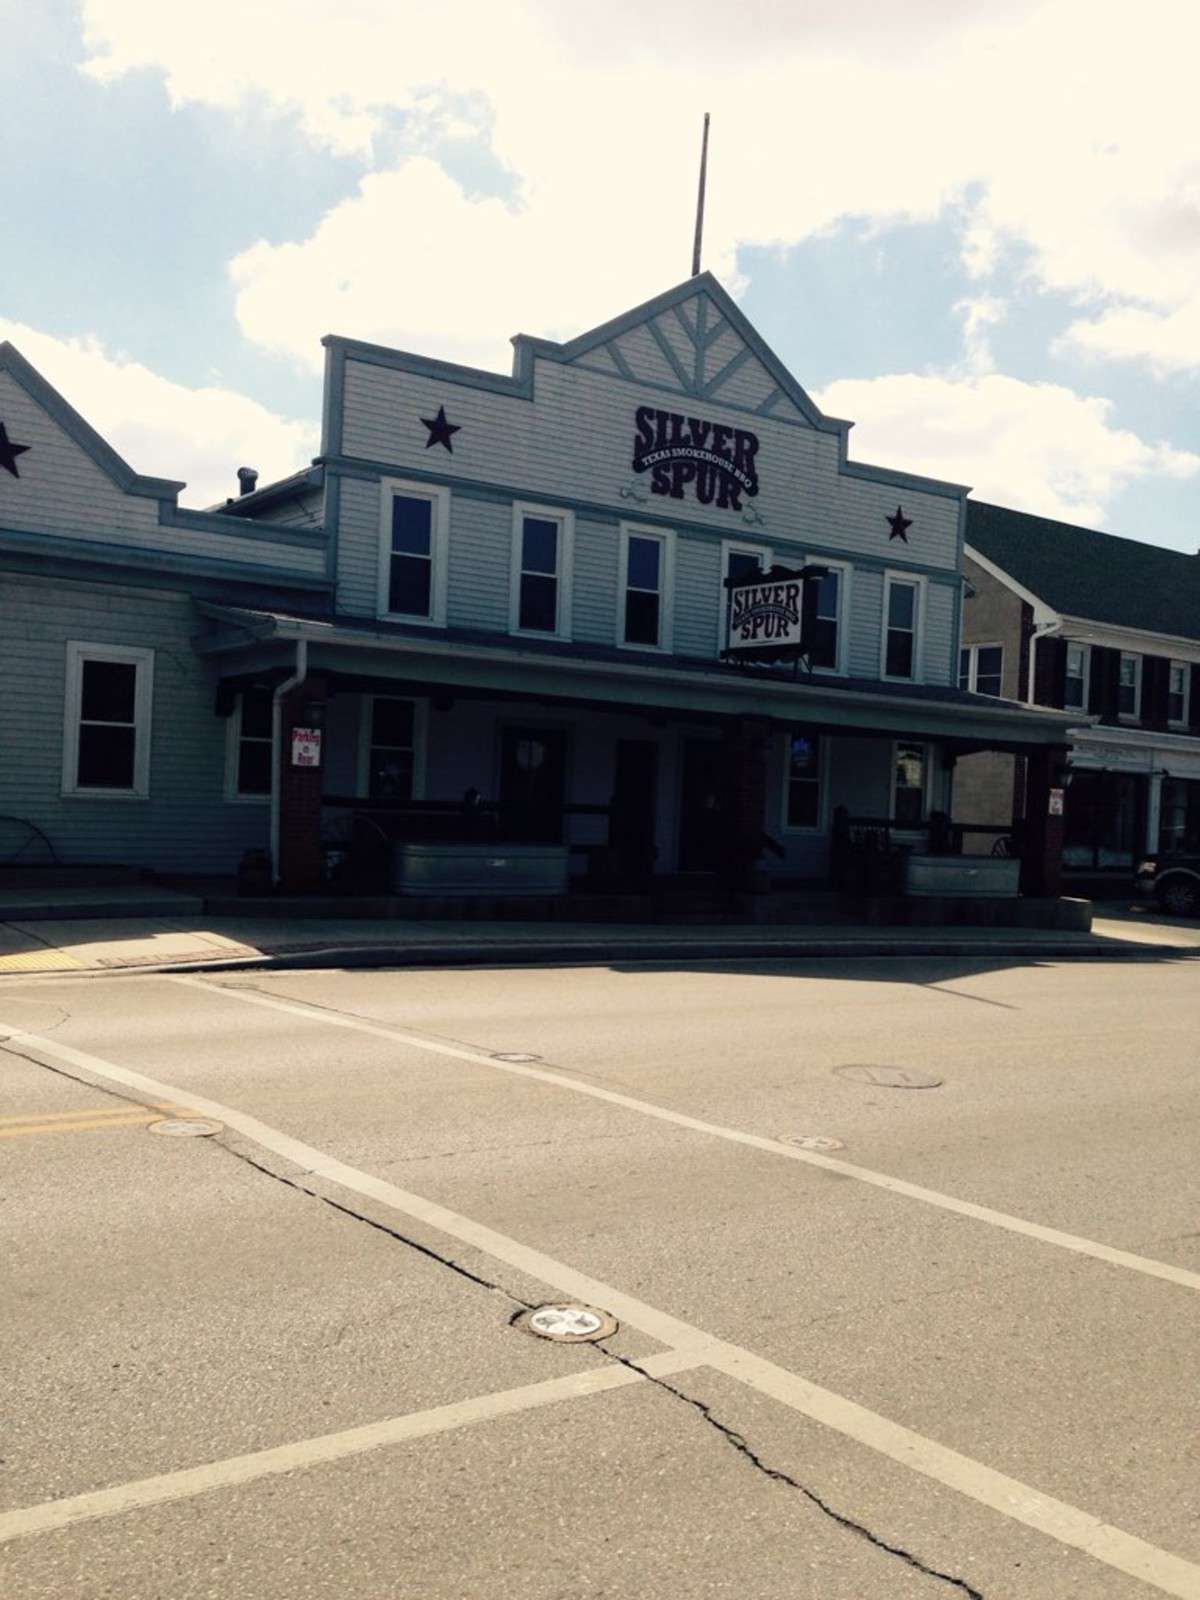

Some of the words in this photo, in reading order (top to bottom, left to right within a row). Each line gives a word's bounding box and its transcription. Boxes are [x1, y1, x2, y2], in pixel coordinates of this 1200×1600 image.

[634, 406, 760, 478] SILVER
[641, 448, 671, 467] TEXAS
[672, 447, 736, 474] SMOKEHOUSE
[651, 462, 743, 511] SPUR
[733, 583, 800, 616] SILVER
[740, 614, 790, 640] SPUR
